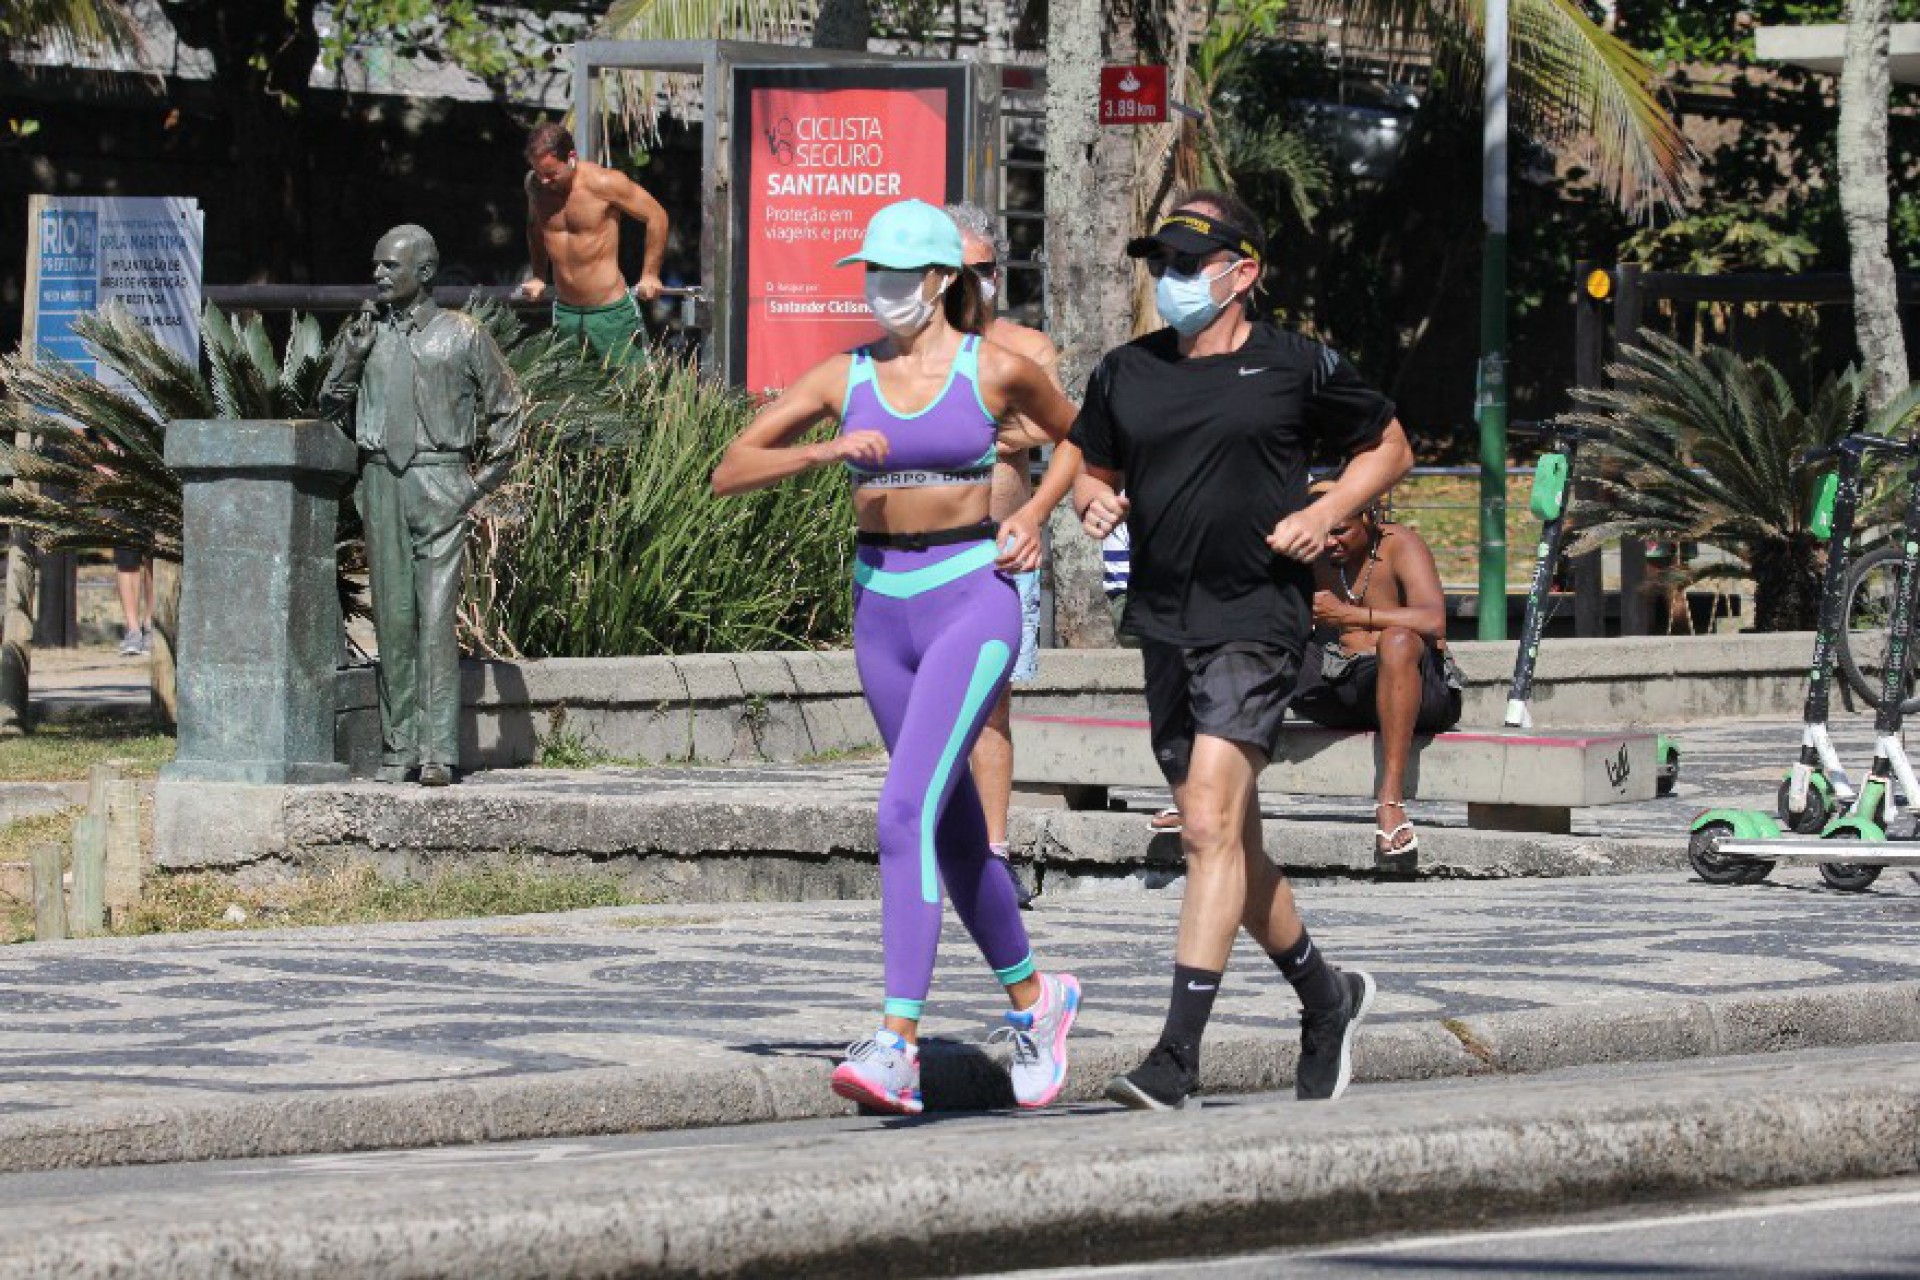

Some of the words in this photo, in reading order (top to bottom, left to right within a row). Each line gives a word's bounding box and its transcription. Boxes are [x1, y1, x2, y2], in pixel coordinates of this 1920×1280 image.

[1104, 98, 1135, 117] 3.89
[1137, 102, 1157, 117] km
[796, 117, 883, 141] CICLISTA
[796, 144, 883, 168] SEGURO
[767, 173, 901, 196] SANTANDER
[765, 205, 826, 225] Proteção
[829, 210, 853, 222] em
[43, 217, 80, 254] RIO
[764, 225, 818, 243] viagens
[820, 229, 831, 241] e
[769, 300, 829, 314] Santander
